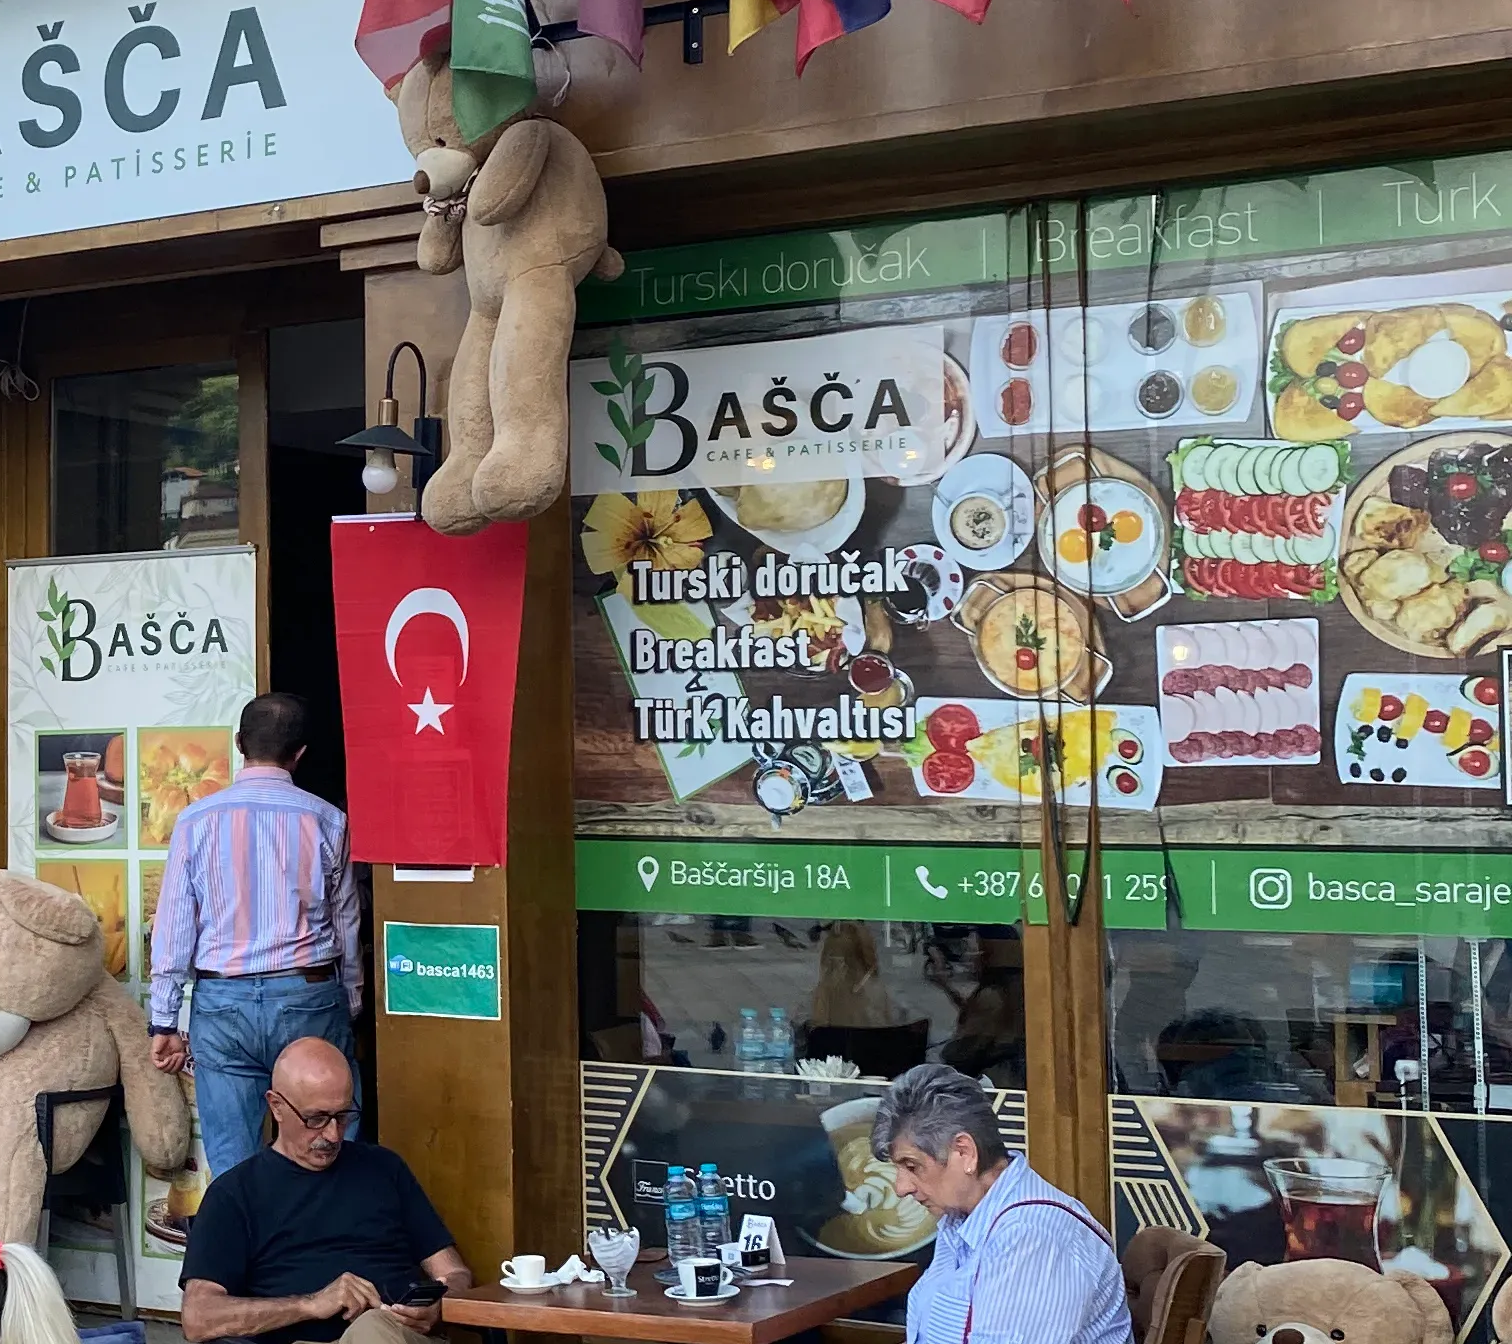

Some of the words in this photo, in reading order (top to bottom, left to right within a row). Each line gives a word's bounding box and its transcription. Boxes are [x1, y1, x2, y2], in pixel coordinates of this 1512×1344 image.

[26, 172, 41, 193] &
[1382, 171, 1502, 227] Türk
[1036, 202, 1259, 263] Breakfast
[761, 237, 930, 294] doručak
[630, 361, 912, 477] BAŠČA
[707, 448, 753, 462] CAFE
[765, 447, 775, 458] &
[633, 555, 741, 601] Turski
[755, 547, 910, 597] doručak
[62, 598, 229, 682] BAŠČA
[636, 626, 811, 671] Breakfast
[635, 695, 716, 740] Türk
[727, 694, 916, 740] Kahvaltısı
[670, 860, 795, 894] Baščaršija
[804, 864, 851, 890] 18A
[957, 870, 1021, 898] +387
[1307, 871, 1511, 911] basca_saraje
[416, 961, 495, 980] basca1463
[743, 1233, 764, 1251] 16
